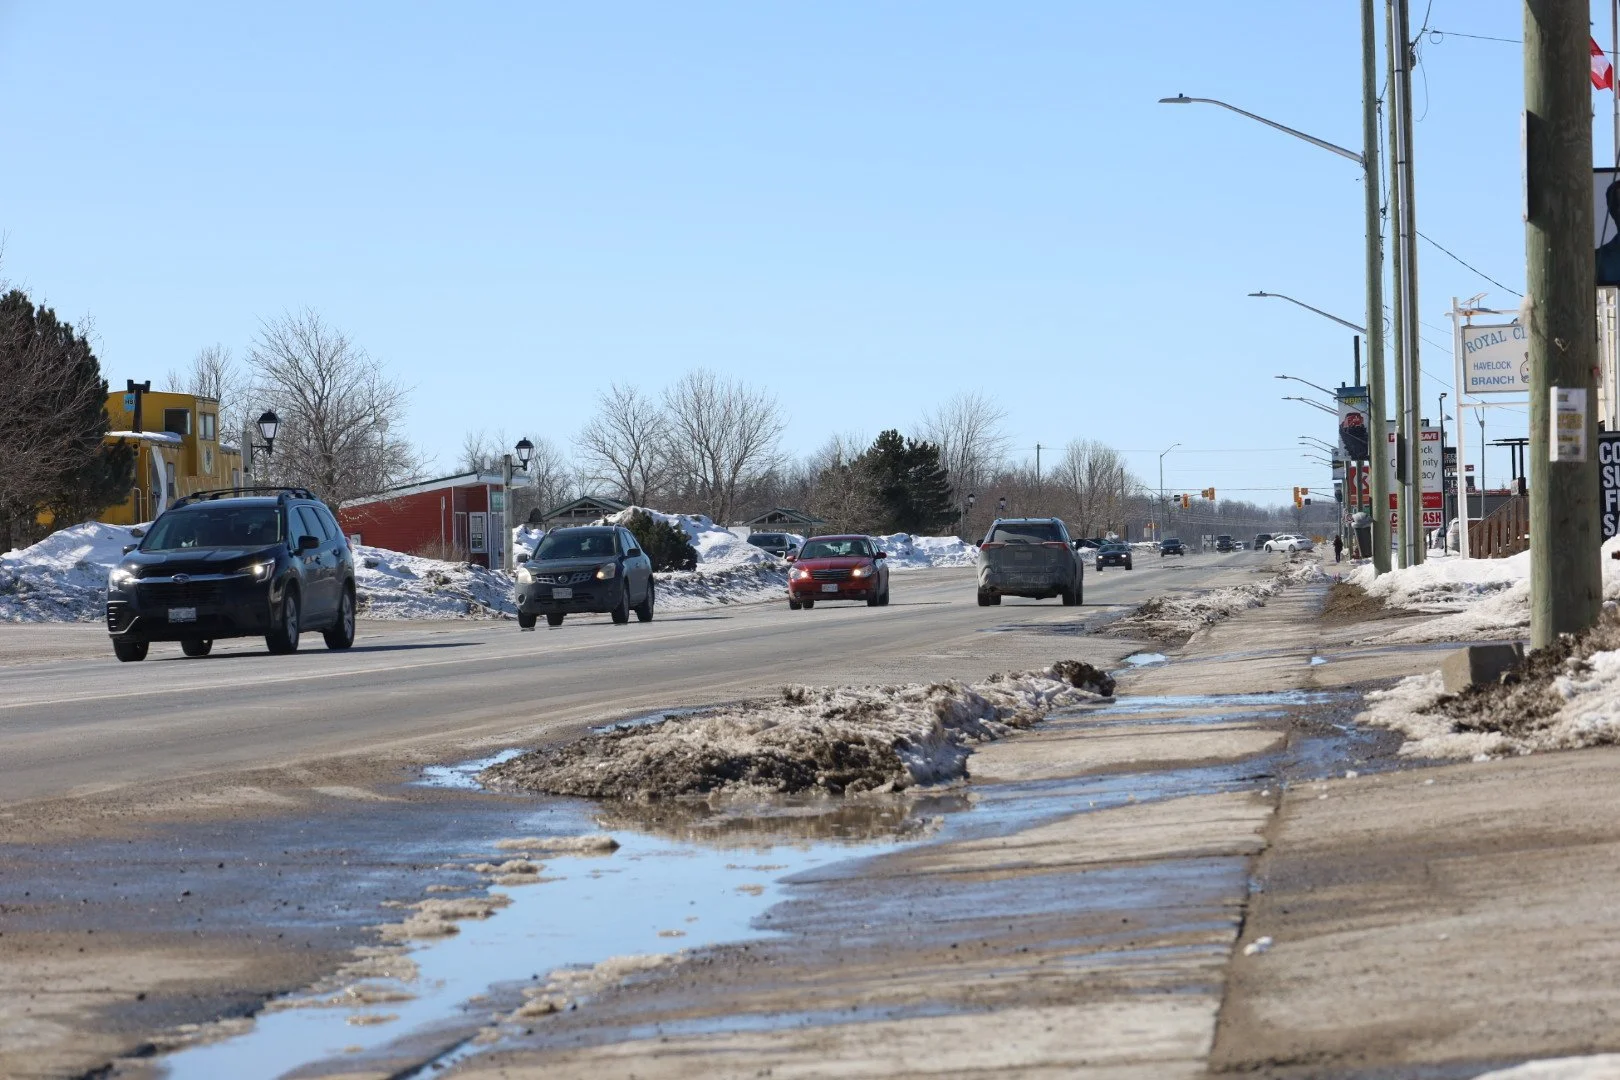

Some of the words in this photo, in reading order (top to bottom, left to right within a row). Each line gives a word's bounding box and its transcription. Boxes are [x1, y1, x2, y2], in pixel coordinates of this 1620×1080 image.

[1465, 330, 1507, 353] ROYAL
[1473, 361, 1512, 371] HAVELOCK
[1471, 376, 1515, 386] BRANCH
